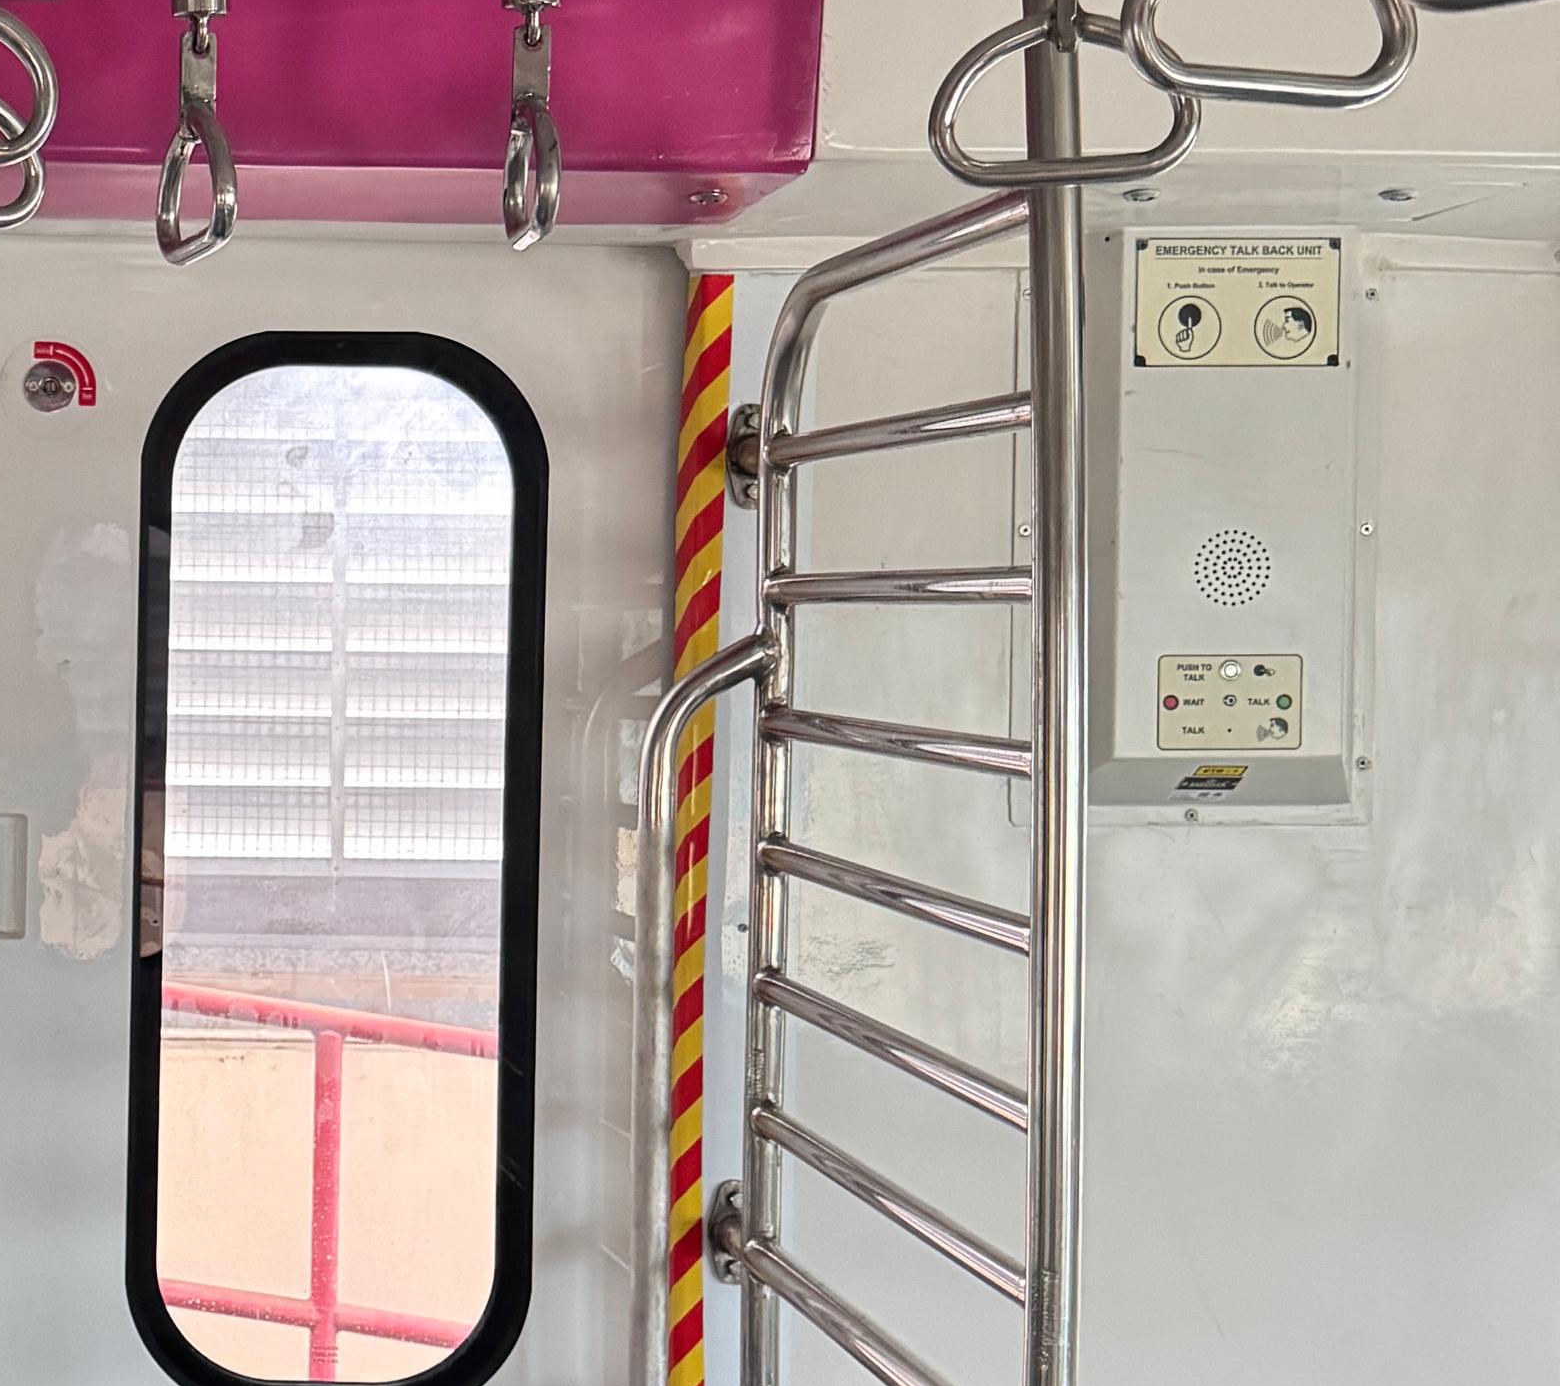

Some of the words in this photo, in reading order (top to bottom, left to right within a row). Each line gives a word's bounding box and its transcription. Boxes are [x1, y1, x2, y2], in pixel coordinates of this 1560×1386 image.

[1155, 245, 1227, 256] EMERGENCY
[1229, 245, 1259, 256] TALK
[1262, 245, 1294, 256] BACK
[1297, 245, 1323, 255] UNIT
[1226, 266, 1236, 274] of
[1237, 266, 1280, 275] Emergency
[1183, 698, 1205, 706] WAIT
[1182, 726, 1205, 734] TALK
